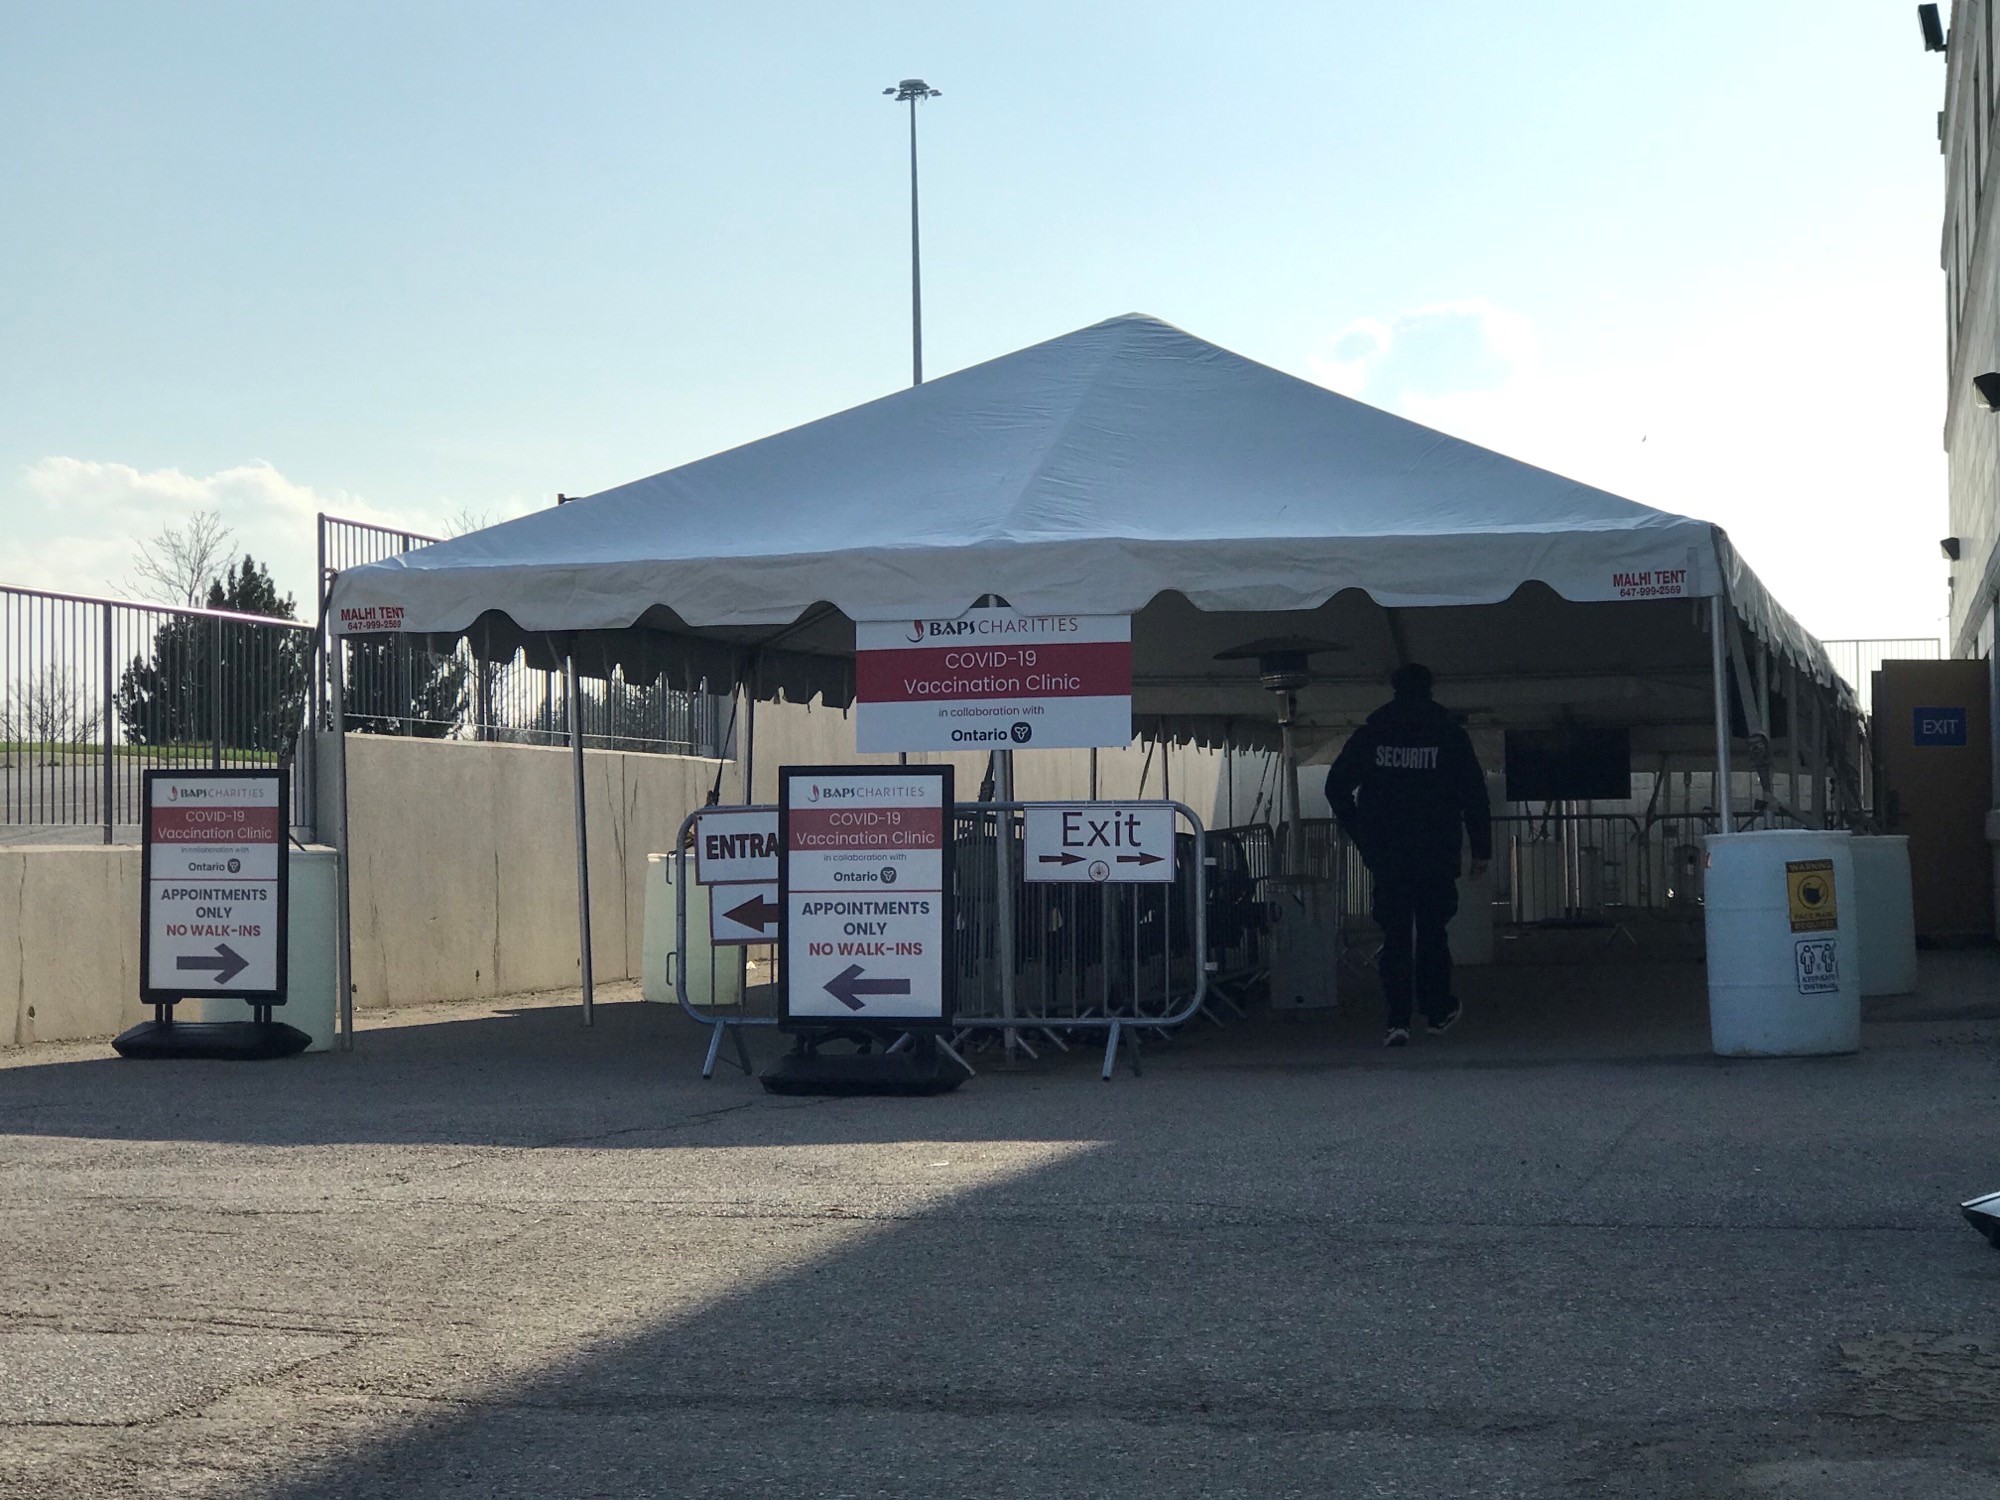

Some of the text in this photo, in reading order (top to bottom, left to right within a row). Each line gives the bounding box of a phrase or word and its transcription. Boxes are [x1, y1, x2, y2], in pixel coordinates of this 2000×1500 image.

[1613, 570, 1686, 587] MALHI TENT
[1620, 585, 1682, 597] 647-999-2569
[340, 606, 404, 621] MALHI TENT
[945, 650, 1037, 669] COVID-19
[904, 673, 1081, 695] Vaccination Clinic
[938, 705, 1045, 717] in collaboration with
[1923, 719, 1959, 735] EXIT
[951, 728, 1008, 742] Ontario
[1376, 745, 1439, 769] SECURITY
[186, 810, 245, 823] COVID-19
[829, 812, 901, 826] COVID-19
[158, 826, 272, 840] Vaccination Clinic
[1062, 810, 1142, 847] Exit
[796, 831, 935, 846] Vaccination Clinic
[833, 853, 888, 861] collaboration
[188, 862, 225, 872] Ontario
[1788, 863, 1832, 872] WARNING
[834, 872, 878, 882] Ontario
[161, 888, 267, 901] APPOINTMENTS
[196, 907, 232, 918] ONLY
[802, 901, 930, 916] APPOINTMENTS
[166, 924, 261, 937] NO WALK-INS
[843, 922, 887, 936] ONLY
[809, 942, 923, 956] NO WALK-INS
